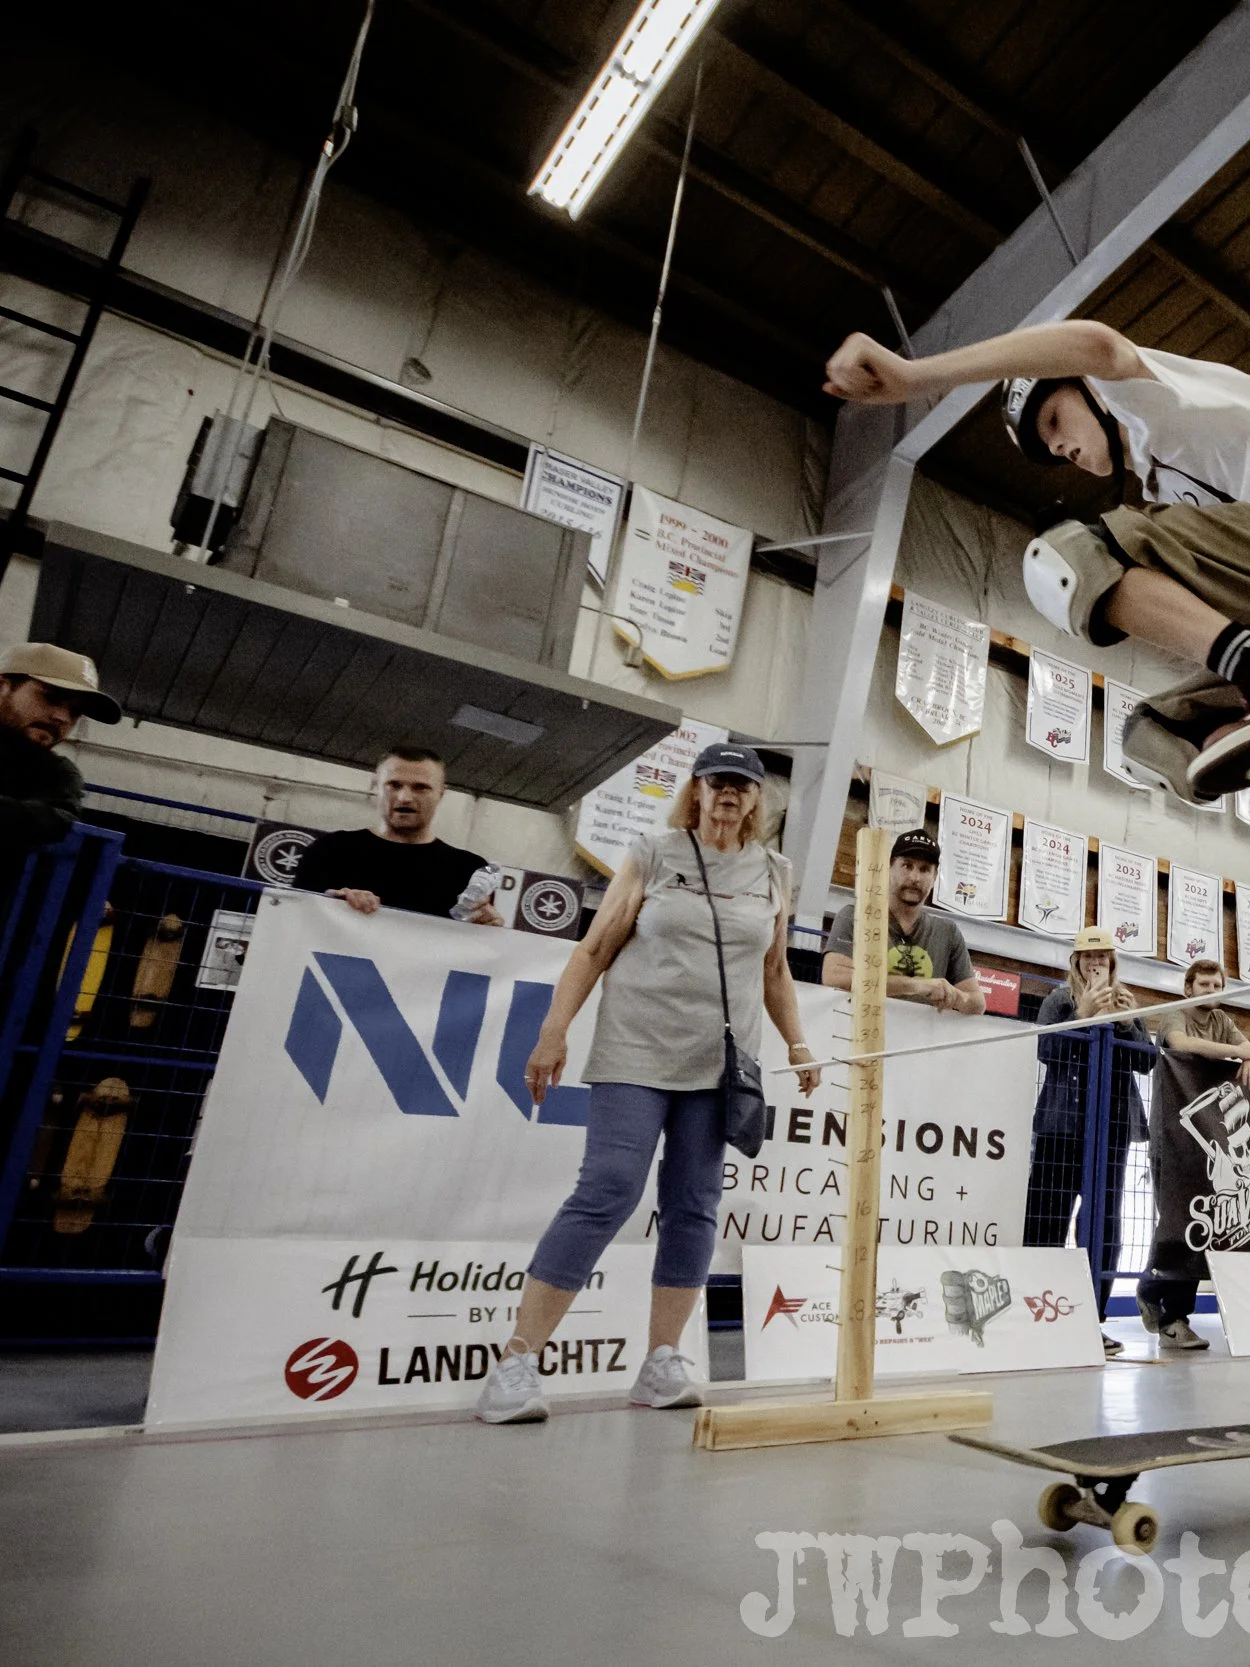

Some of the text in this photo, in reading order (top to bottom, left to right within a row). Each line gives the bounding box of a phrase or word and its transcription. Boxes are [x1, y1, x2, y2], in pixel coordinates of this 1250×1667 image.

[702, 530, 729, 549] 2000
[960, 815, 992, 834] 2024
[1042, 837, 1071, 856] 2024
[1116, 863, 1142, 881] 2023
[865, 885, 883, 897] 42
[1184, 883, 1208, 897] 2022
[864, 906, 882, 921] 40
[863, 928, 881, 943] 38
[863, 954, 881, 970] 36
[863, 979, 880, 994] 34
[861, 1003, 881, 1019] 32
[860, 1027, 881, 1045] 30
[859, 1102, 877, 1114] 24
[856, 1149, 876, 1164] 20
[955, 1185, 969, 1201] +
[855, 1201, 871, 1217] 16
[854, 1247, 869, 1266] 12
[409, 1260, 526, 1293] Holida
[468, 1306, 497, 1323] BY
[811, 1302, 832, 1312] ACE
[854, 1299, 865, 1321] 8
[377, 1338, 627, 1386] LANDCHTZ
